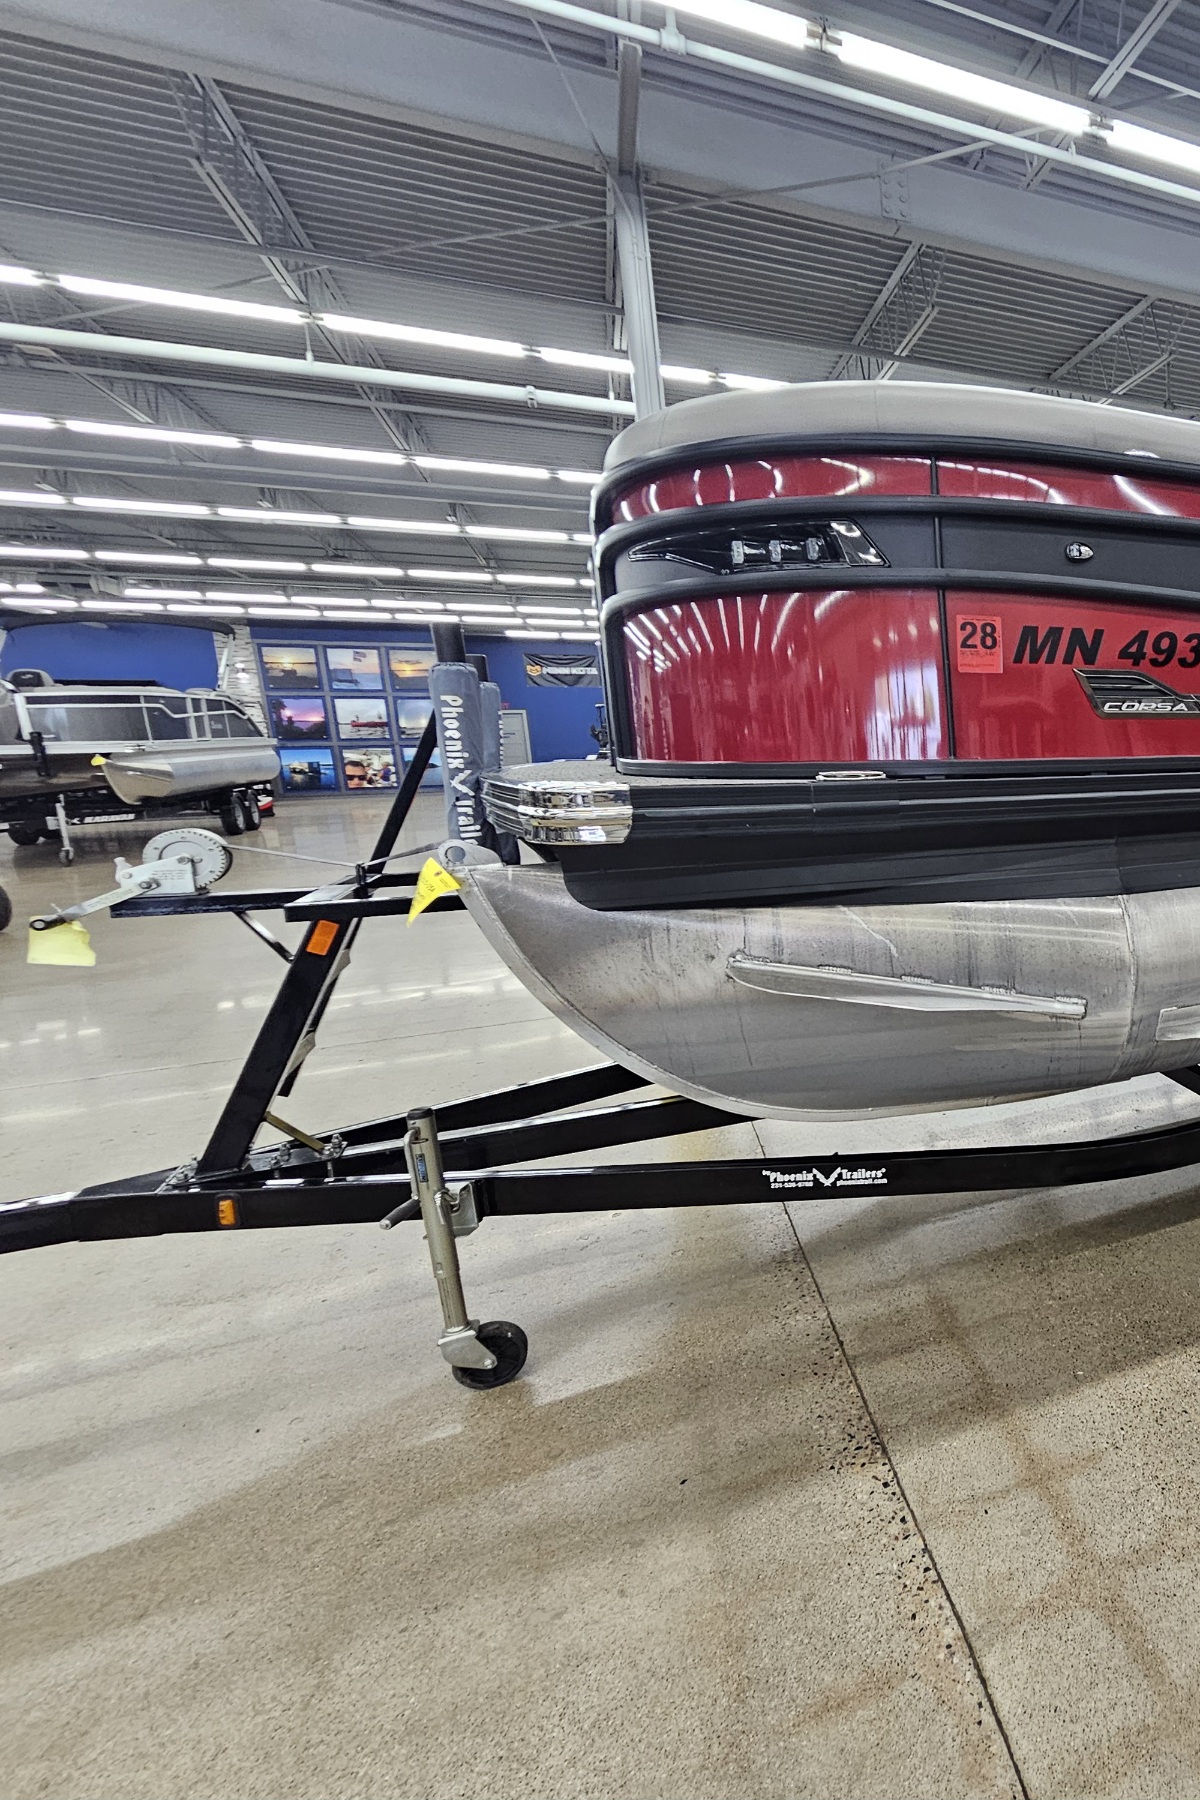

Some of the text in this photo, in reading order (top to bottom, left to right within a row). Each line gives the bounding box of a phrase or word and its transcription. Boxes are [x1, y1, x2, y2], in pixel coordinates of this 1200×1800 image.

[960, 621, 998, 650] 28
[1012, 625, 1104, 666] MN
[1103, 702, 1188, 712] CORSA
[439, 694, 471, 770] Phoenix
[769, 1171, 814, 1183] Phoenix
[841, 1168, 883, 1180] Trailers
